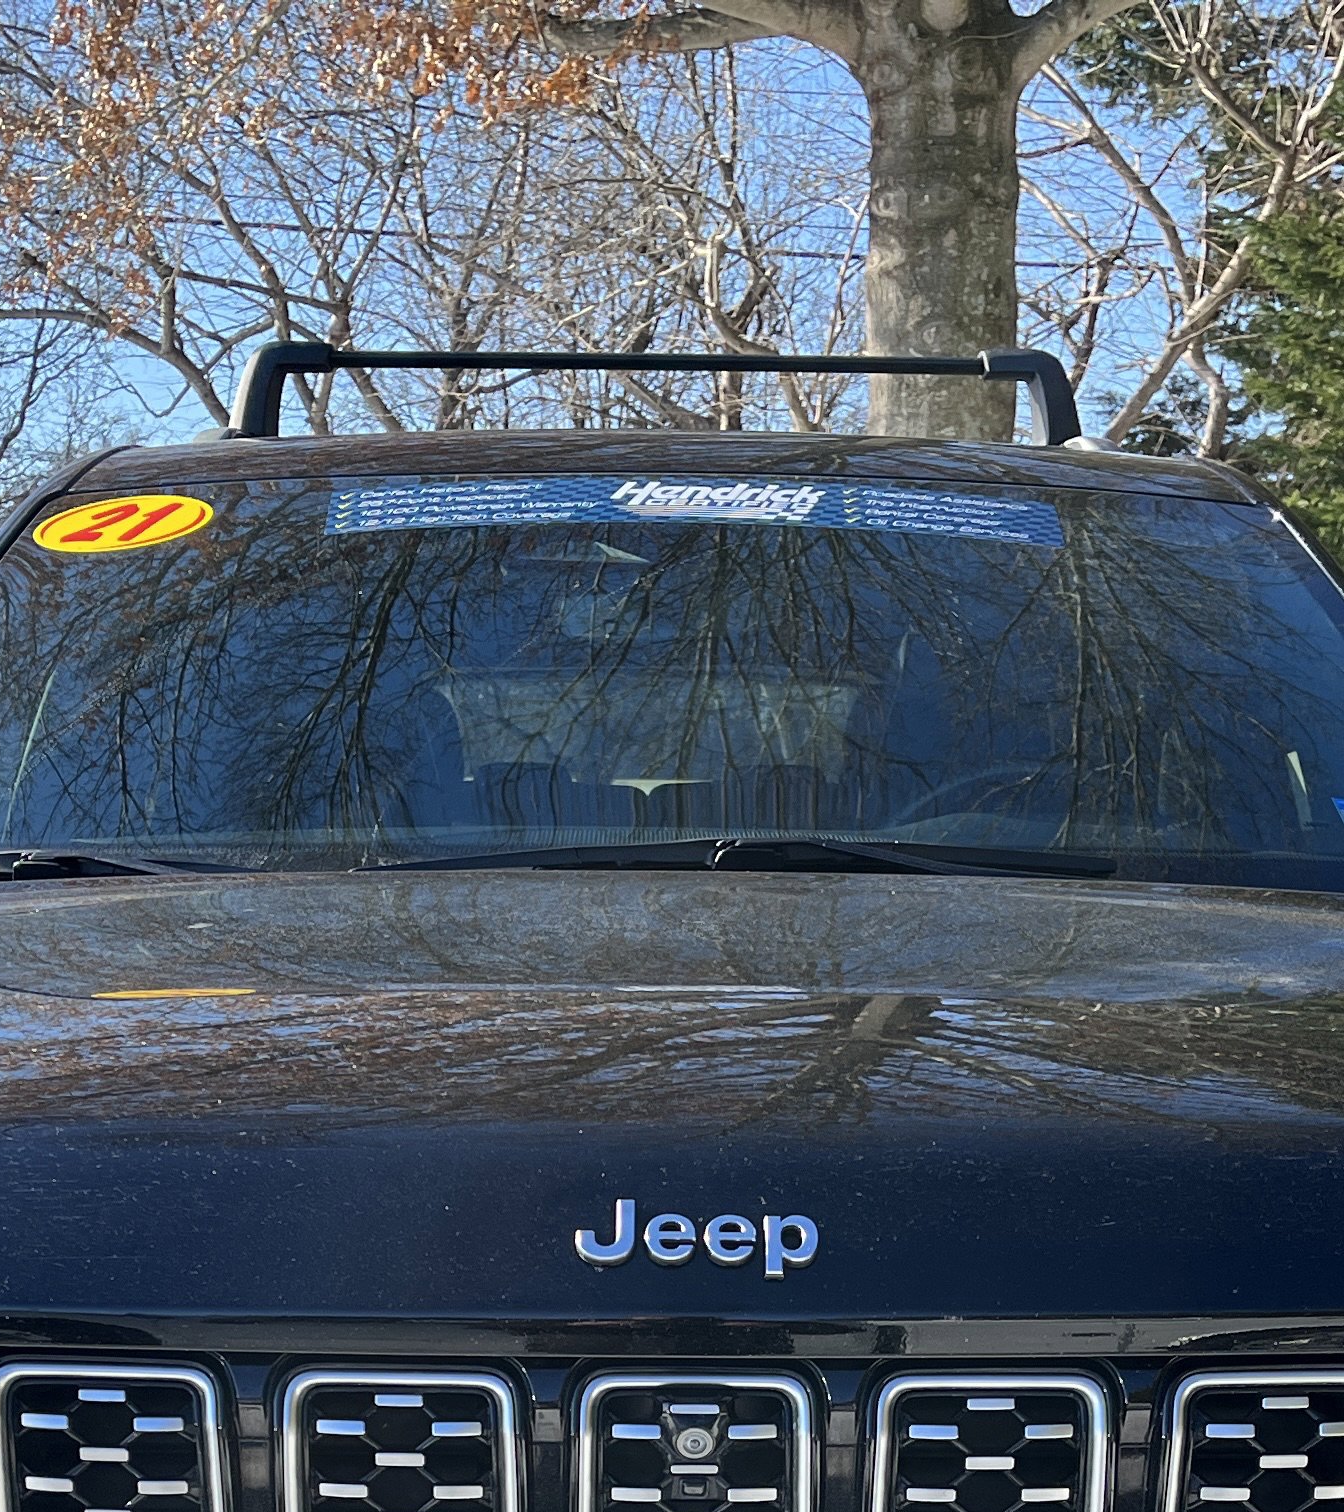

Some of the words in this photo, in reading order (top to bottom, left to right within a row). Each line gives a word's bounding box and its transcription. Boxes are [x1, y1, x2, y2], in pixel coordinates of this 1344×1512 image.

[610, 481, 827, 506] Hendrick
[644, 499, 815, 509] CERTIFIED
[60, 502, 184, 543] 21
[574, 1199, 819, 1281] Jeep
